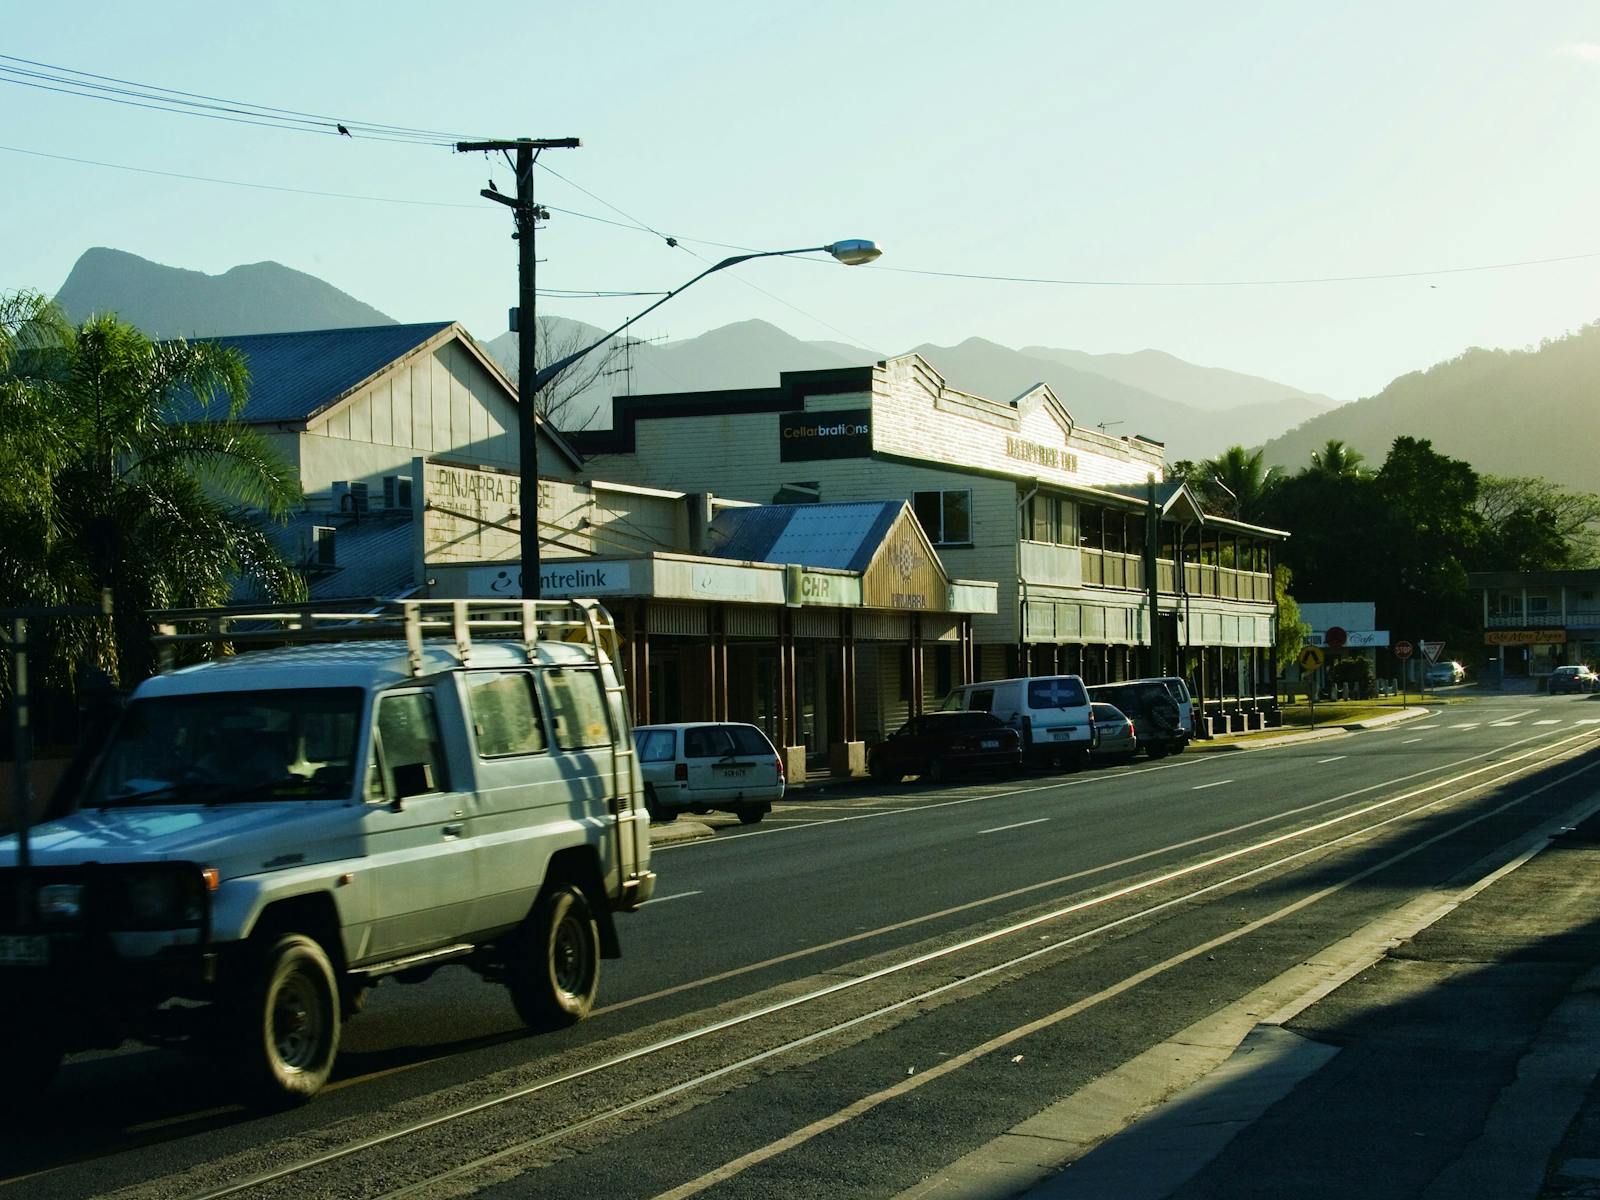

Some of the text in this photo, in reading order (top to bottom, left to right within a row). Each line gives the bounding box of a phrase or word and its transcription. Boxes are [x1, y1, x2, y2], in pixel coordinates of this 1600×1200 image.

[439, 469, 550, 508] PINJARRA PCE
[518, 569, 606, 589] ntrelink
[802, 576, 829, 597] CHR
[1395, 646, 1412, 654] STOP
